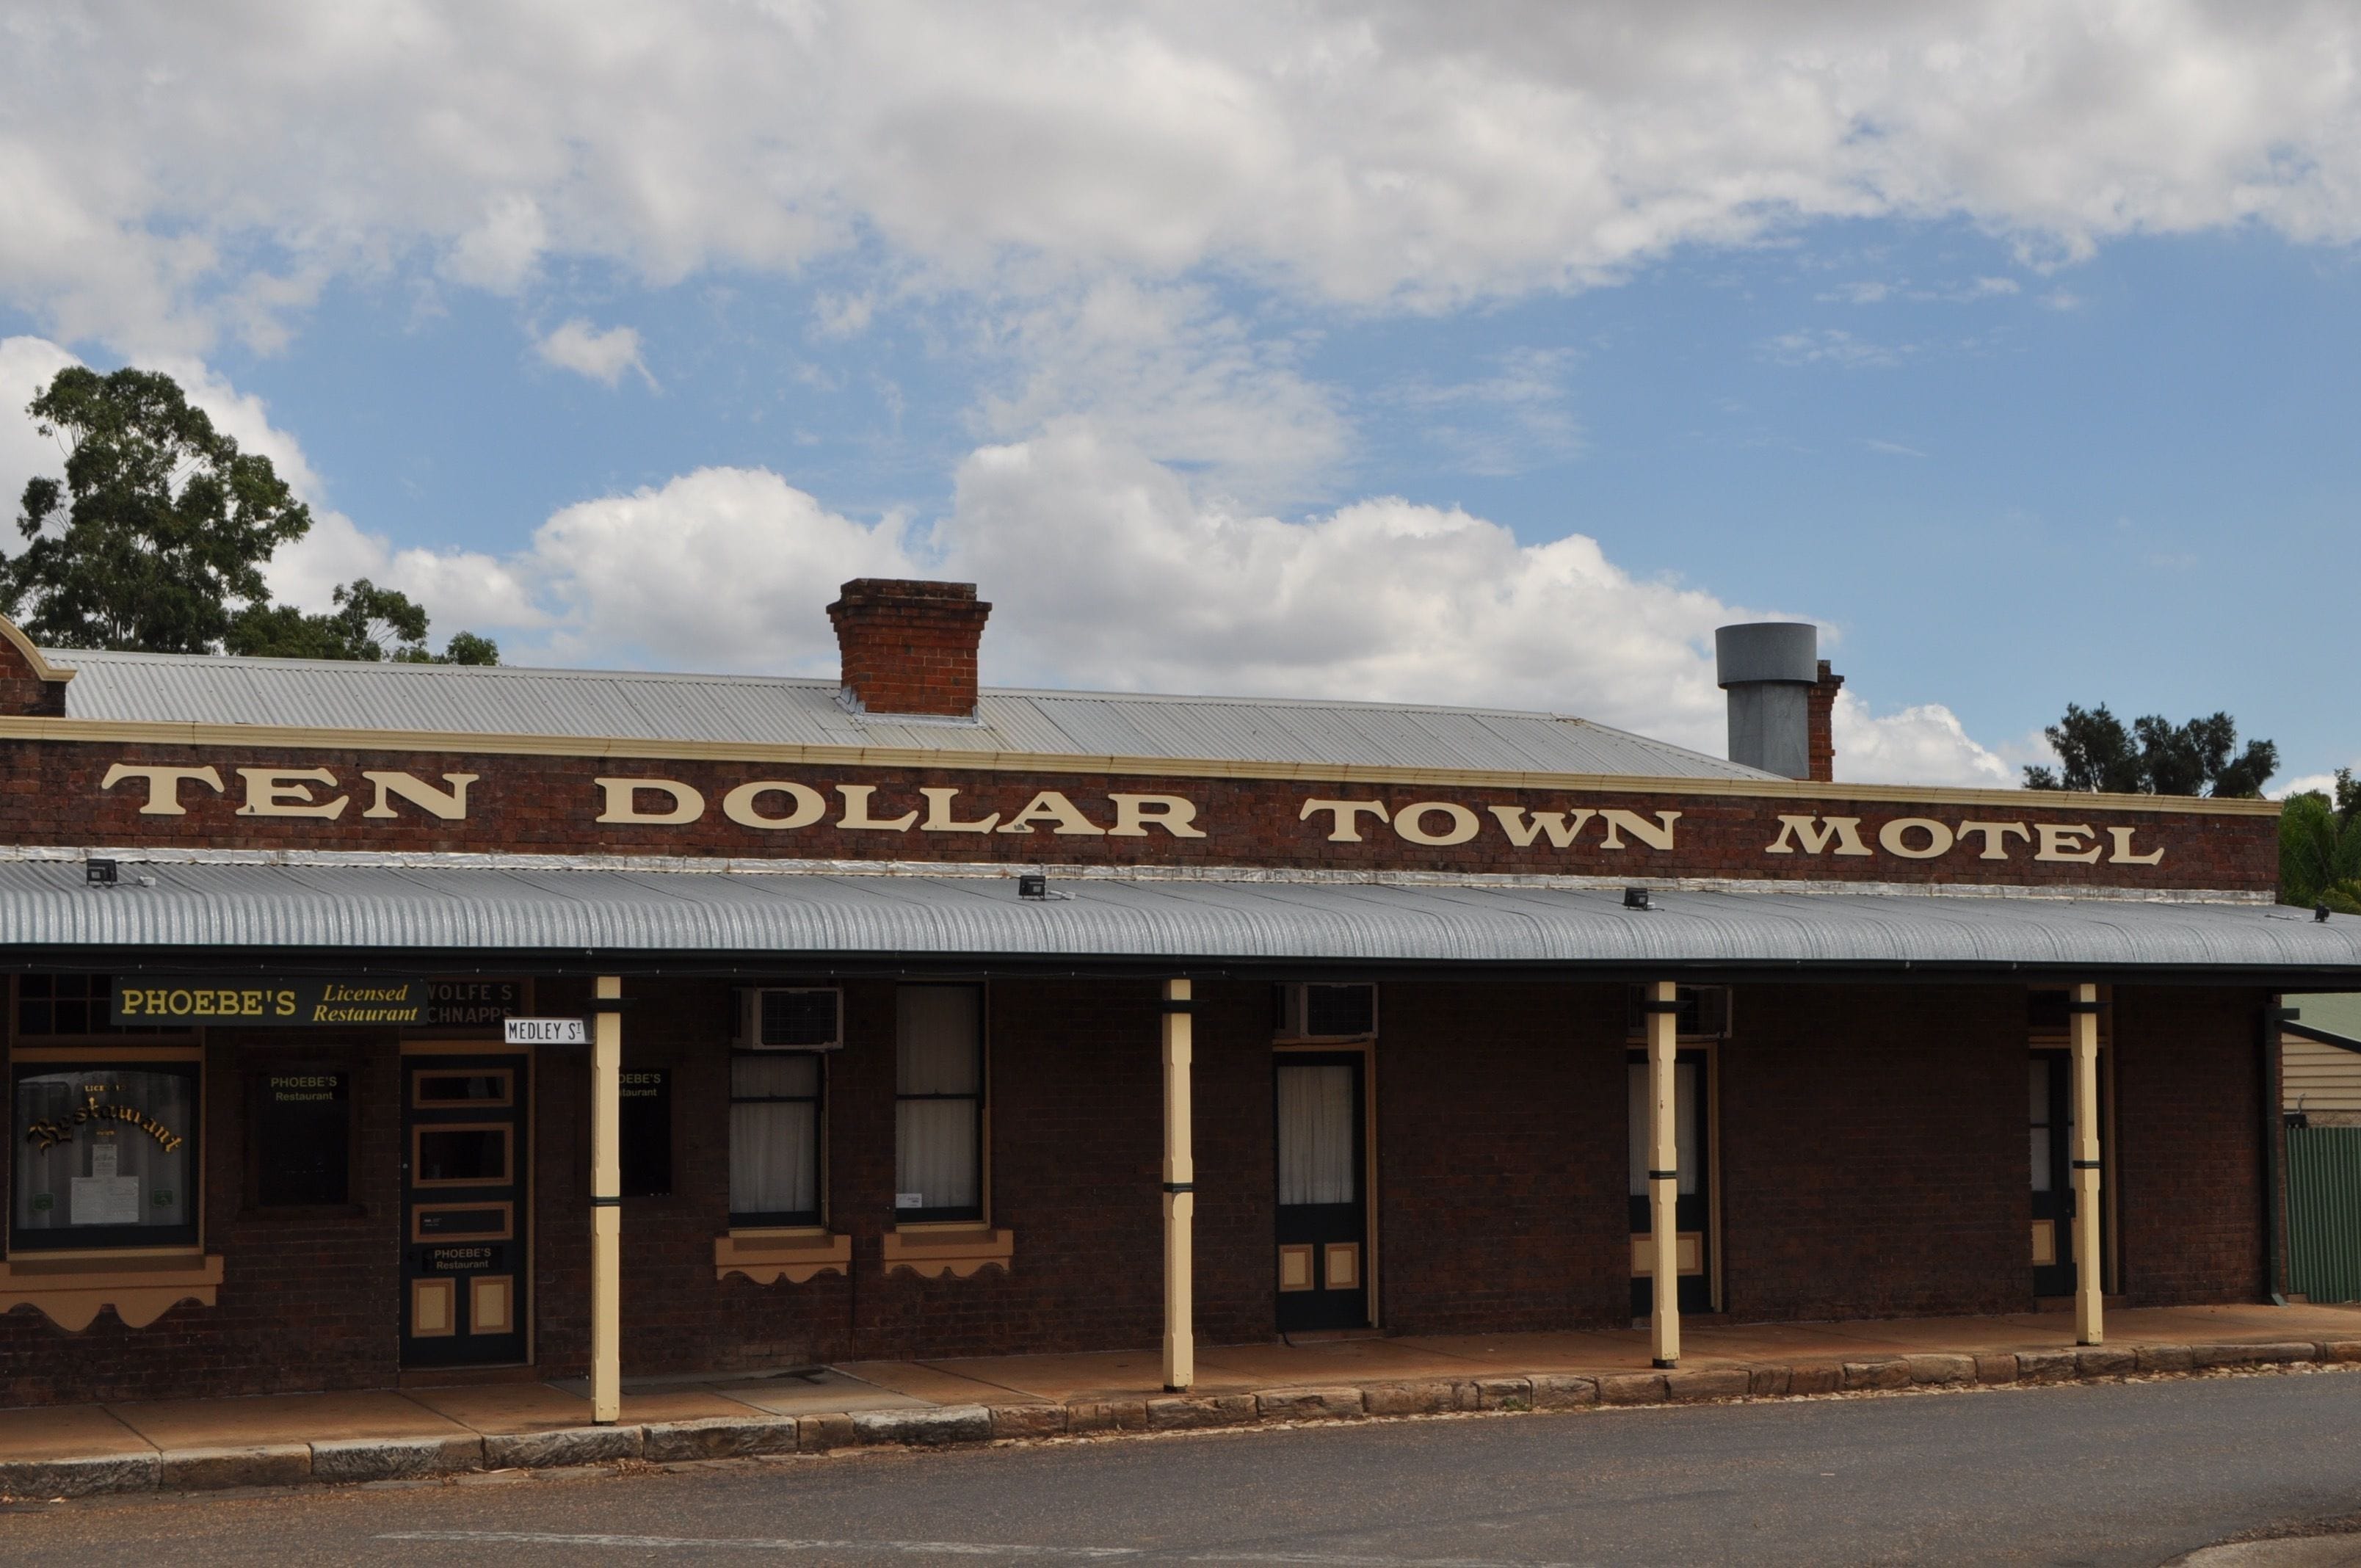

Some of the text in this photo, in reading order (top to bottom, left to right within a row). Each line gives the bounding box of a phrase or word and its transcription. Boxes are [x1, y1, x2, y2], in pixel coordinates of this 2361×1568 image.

[101, 763, 2165, 865] TEN DOLLAR TOWN MOTEL
[322, 984, 409, 1003] Licensed
[121, 990, 296, 1015] PHOEBE'S
[312, 1004, 419, 1022] Restaurant
[427, 1006, 513, 1023] CHNAPPS
[509, 1022, 562, 1039] MEDLEY
[270, 1076, 338, 1088] PHOEBE'S
[619, 1073, 661, 1084] OEBE'S
[275, 1092, 333, 1102] Restaurant
[620, 1087, 658, 1097] taurant
[434, 1248, 492, 1259] PHOEBE'S
[436, 1260, 489, 1270] Restaurant
